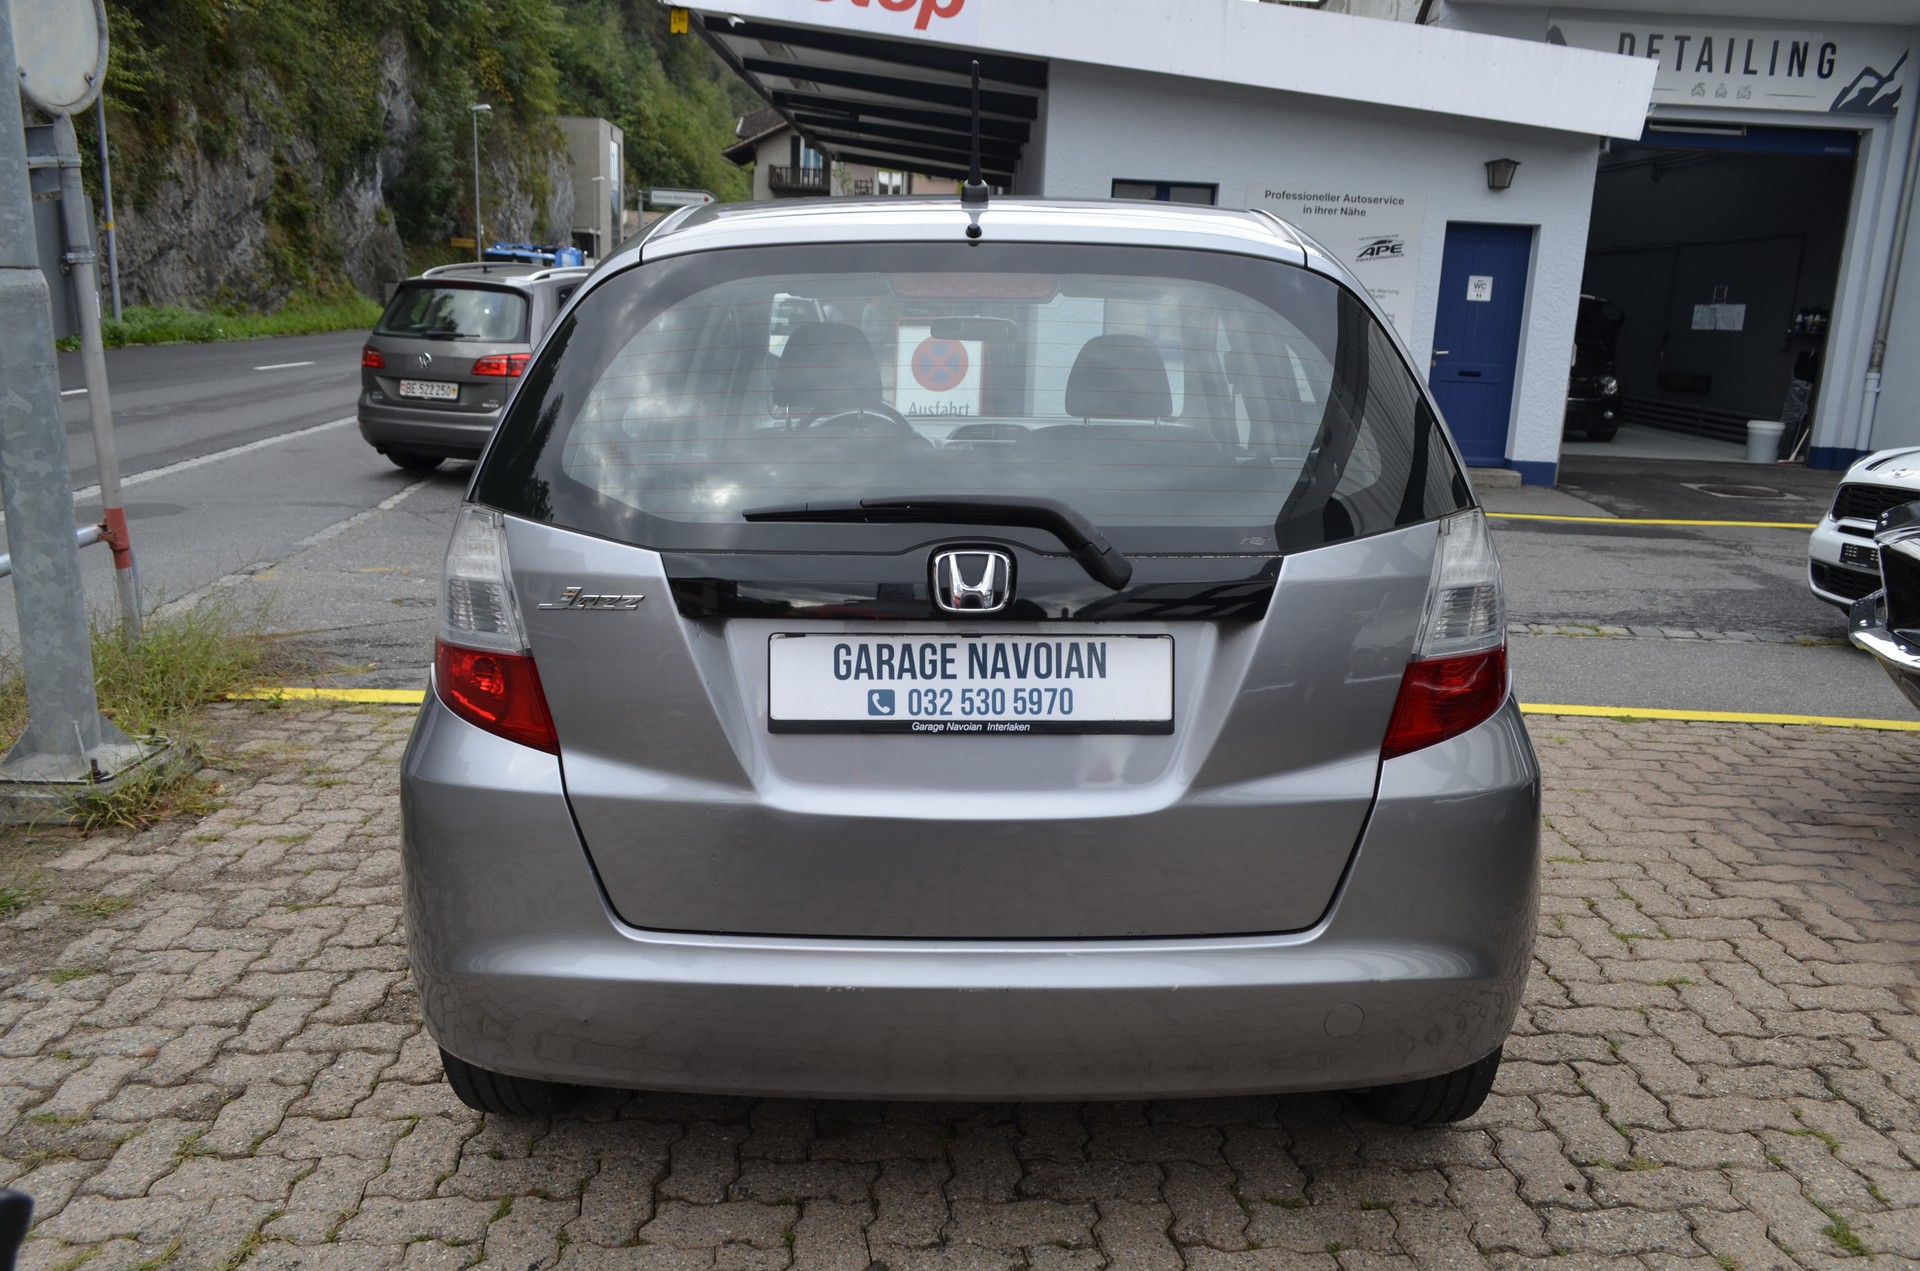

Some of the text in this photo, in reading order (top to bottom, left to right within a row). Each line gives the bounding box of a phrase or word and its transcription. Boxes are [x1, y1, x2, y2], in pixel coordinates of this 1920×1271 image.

[1618, 32, 1837, 79] DETAILING
[1265, 190, 1404, 205] Professioneller Autoservice
[1303, 205, 1366, 217] in ihrer Nähe
[1357, 243, 1403, 258] APE
[1473, 282, 1487, 290] WC
[909, 401, 970, 416] Ausfahrt
[537, 587, 645, 610] Jazz
[833, 641, 1107, 681] GARAGE NAVOIAN
[908, 687, 1073, 716] 032 530 5970
[912, 721, 1030, 732] Garage Navoian Interlaken
